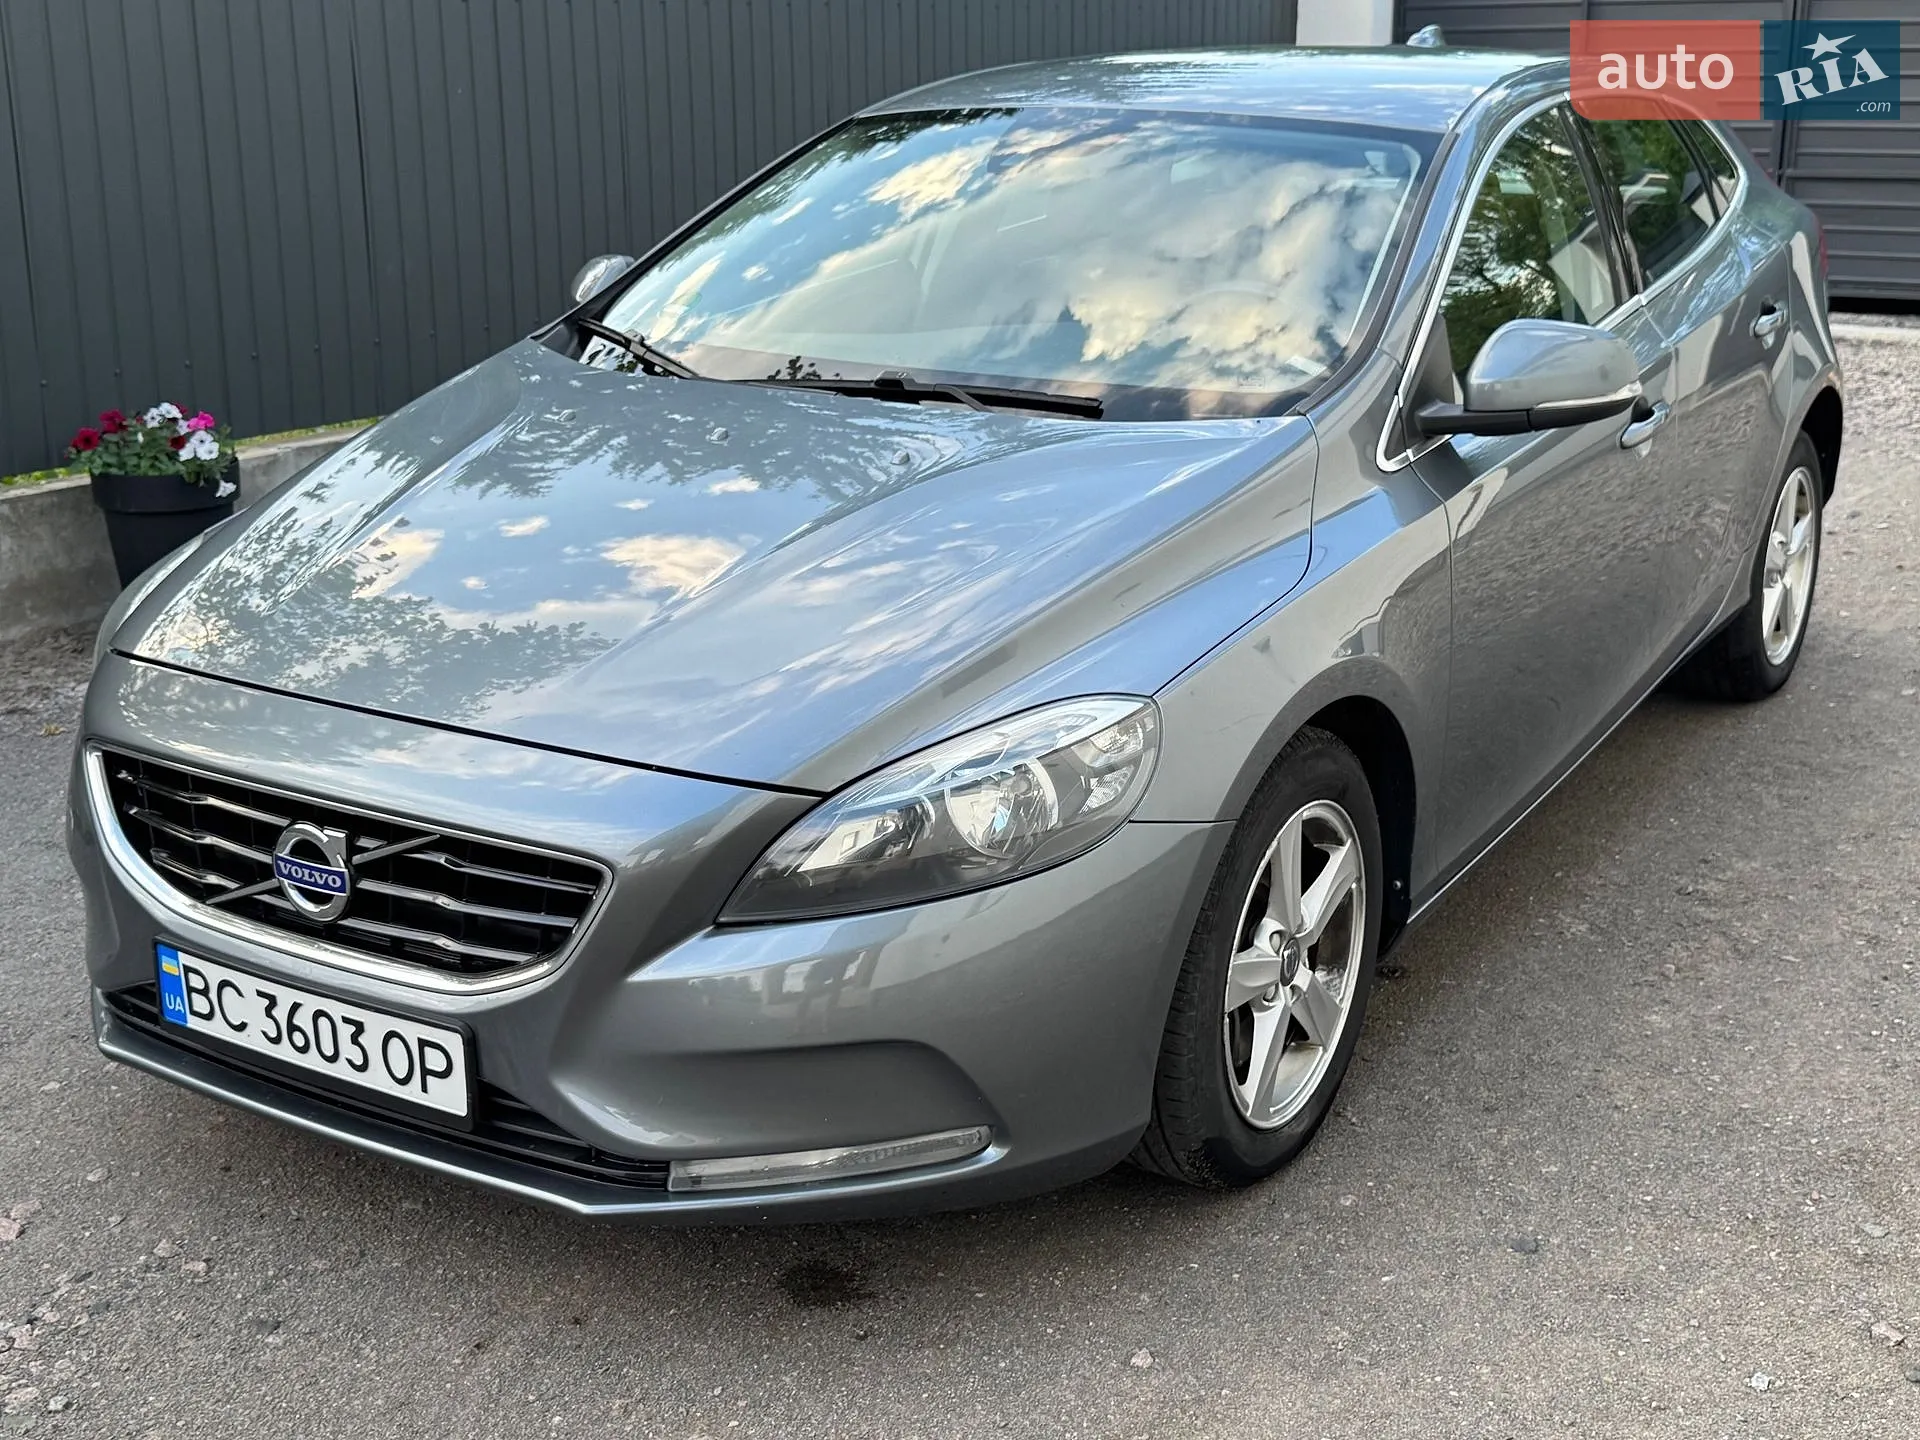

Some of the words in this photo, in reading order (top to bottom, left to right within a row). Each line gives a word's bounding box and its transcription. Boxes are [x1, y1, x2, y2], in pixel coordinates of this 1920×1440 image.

[277, 860, 342, 888] VOLVO
[164, 992, 185, 1014] UA
[182, 963, 248, 1033] BC
[255, 988, 370, 1073] 3603
[381, 1029, 453, 1094] OP
